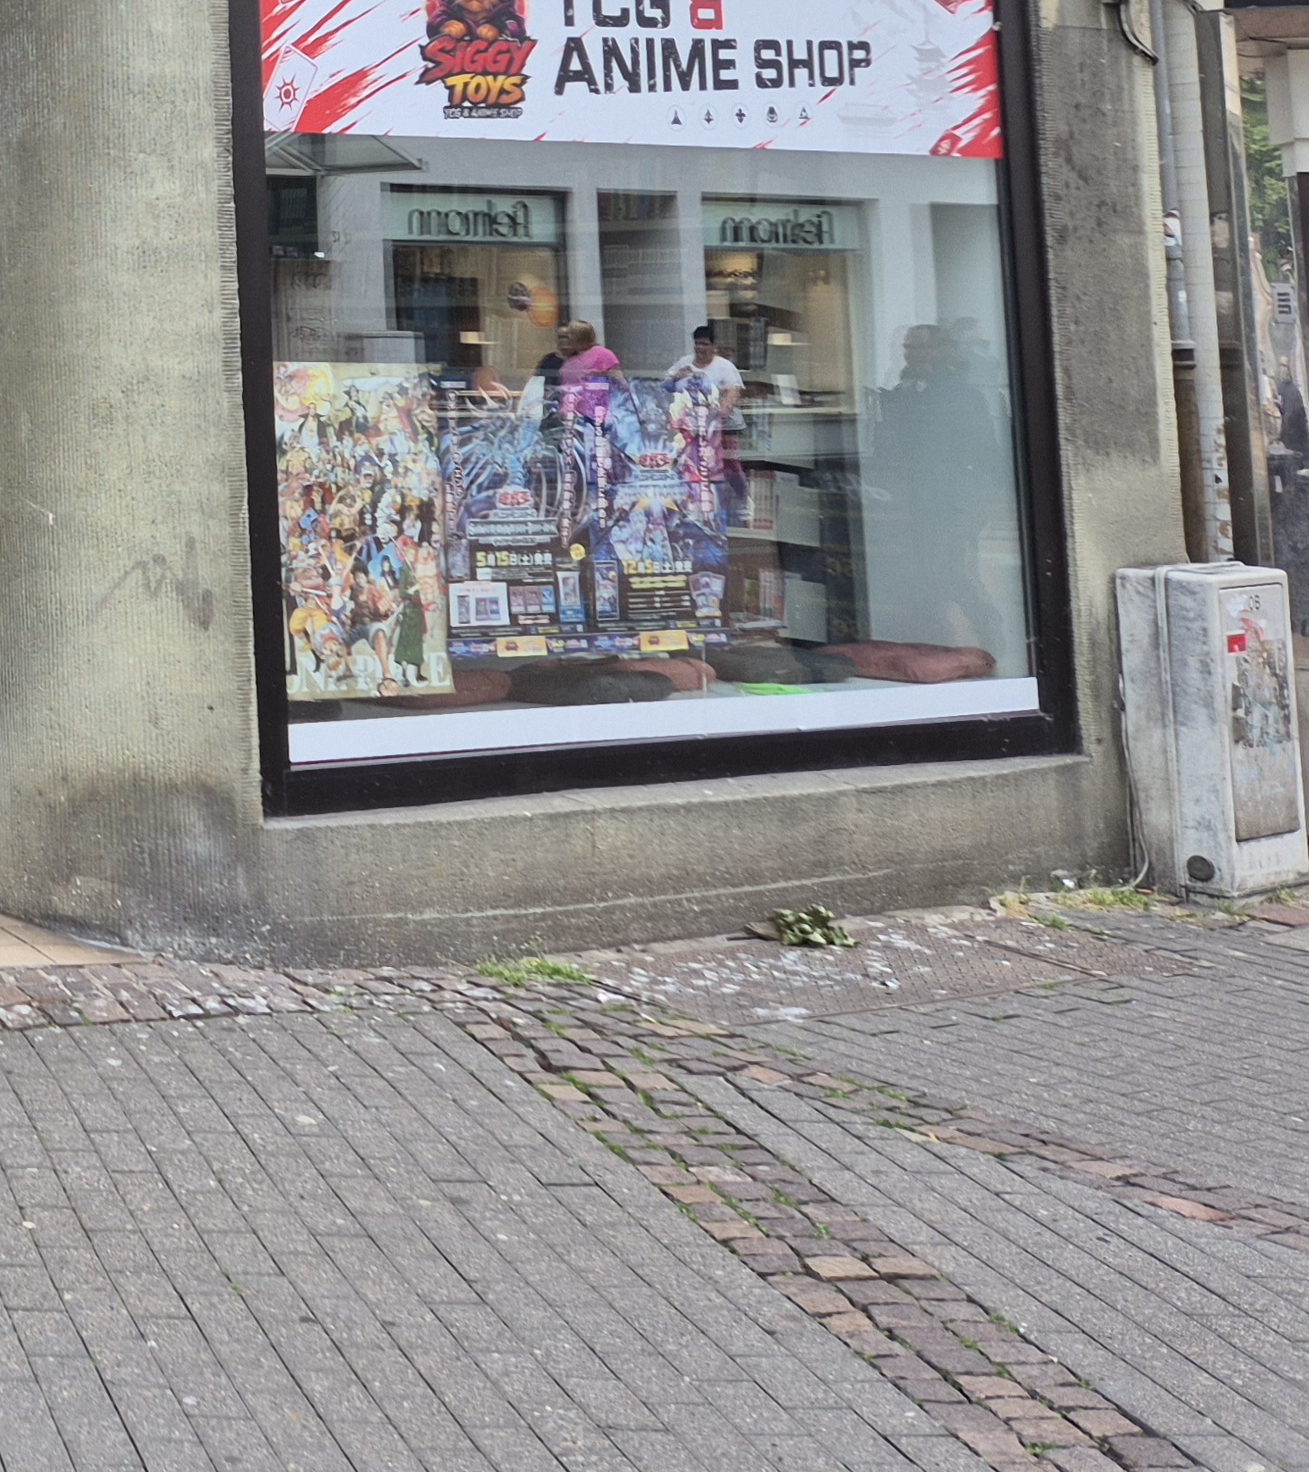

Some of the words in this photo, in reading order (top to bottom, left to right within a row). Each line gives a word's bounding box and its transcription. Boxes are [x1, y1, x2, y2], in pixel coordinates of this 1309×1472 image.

[415, 36, 538, 85] SIGGY
[554, 36, 740, 95] ANIME
[753, 38, 872, 89] SHOP
[443, 74, 526, 105] TOYS
